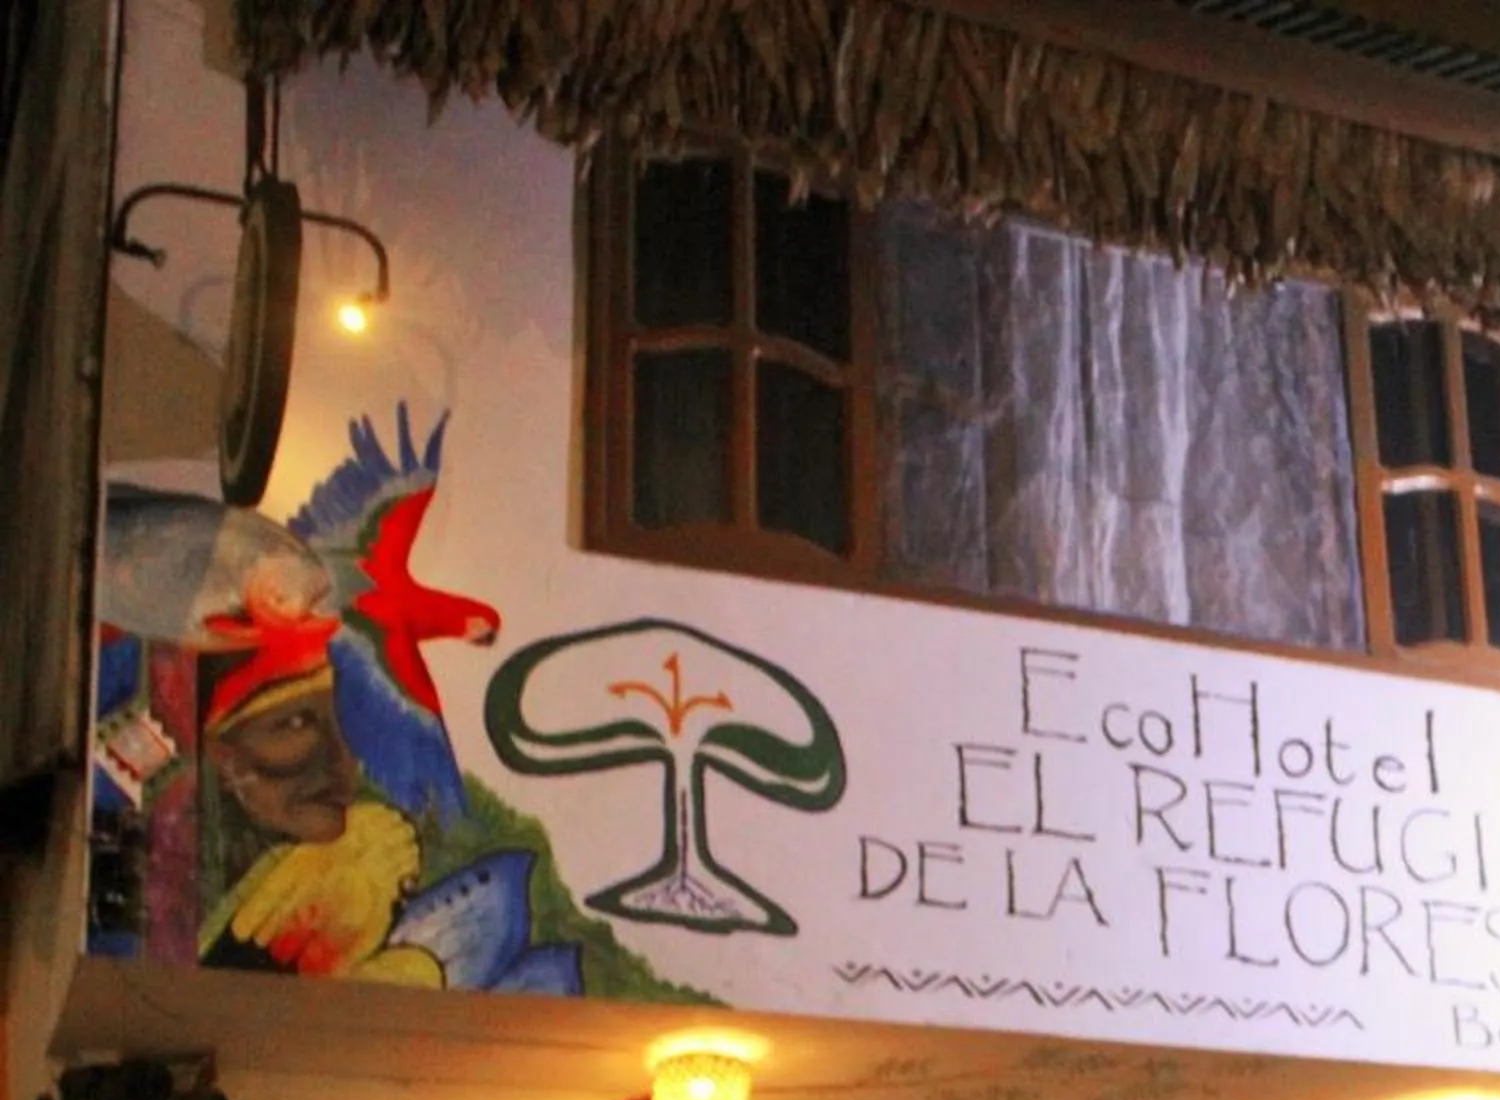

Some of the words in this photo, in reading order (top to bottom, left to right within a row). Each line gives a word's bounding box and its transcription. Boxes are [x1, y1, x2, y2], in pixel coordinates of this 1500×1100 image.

[1019, 647, 1440, 795] EcoHotel
[956, 745, 1095, 843] EL
[859, 836, 967, 910] DE
[1006, 851, 1108, 927] LA
